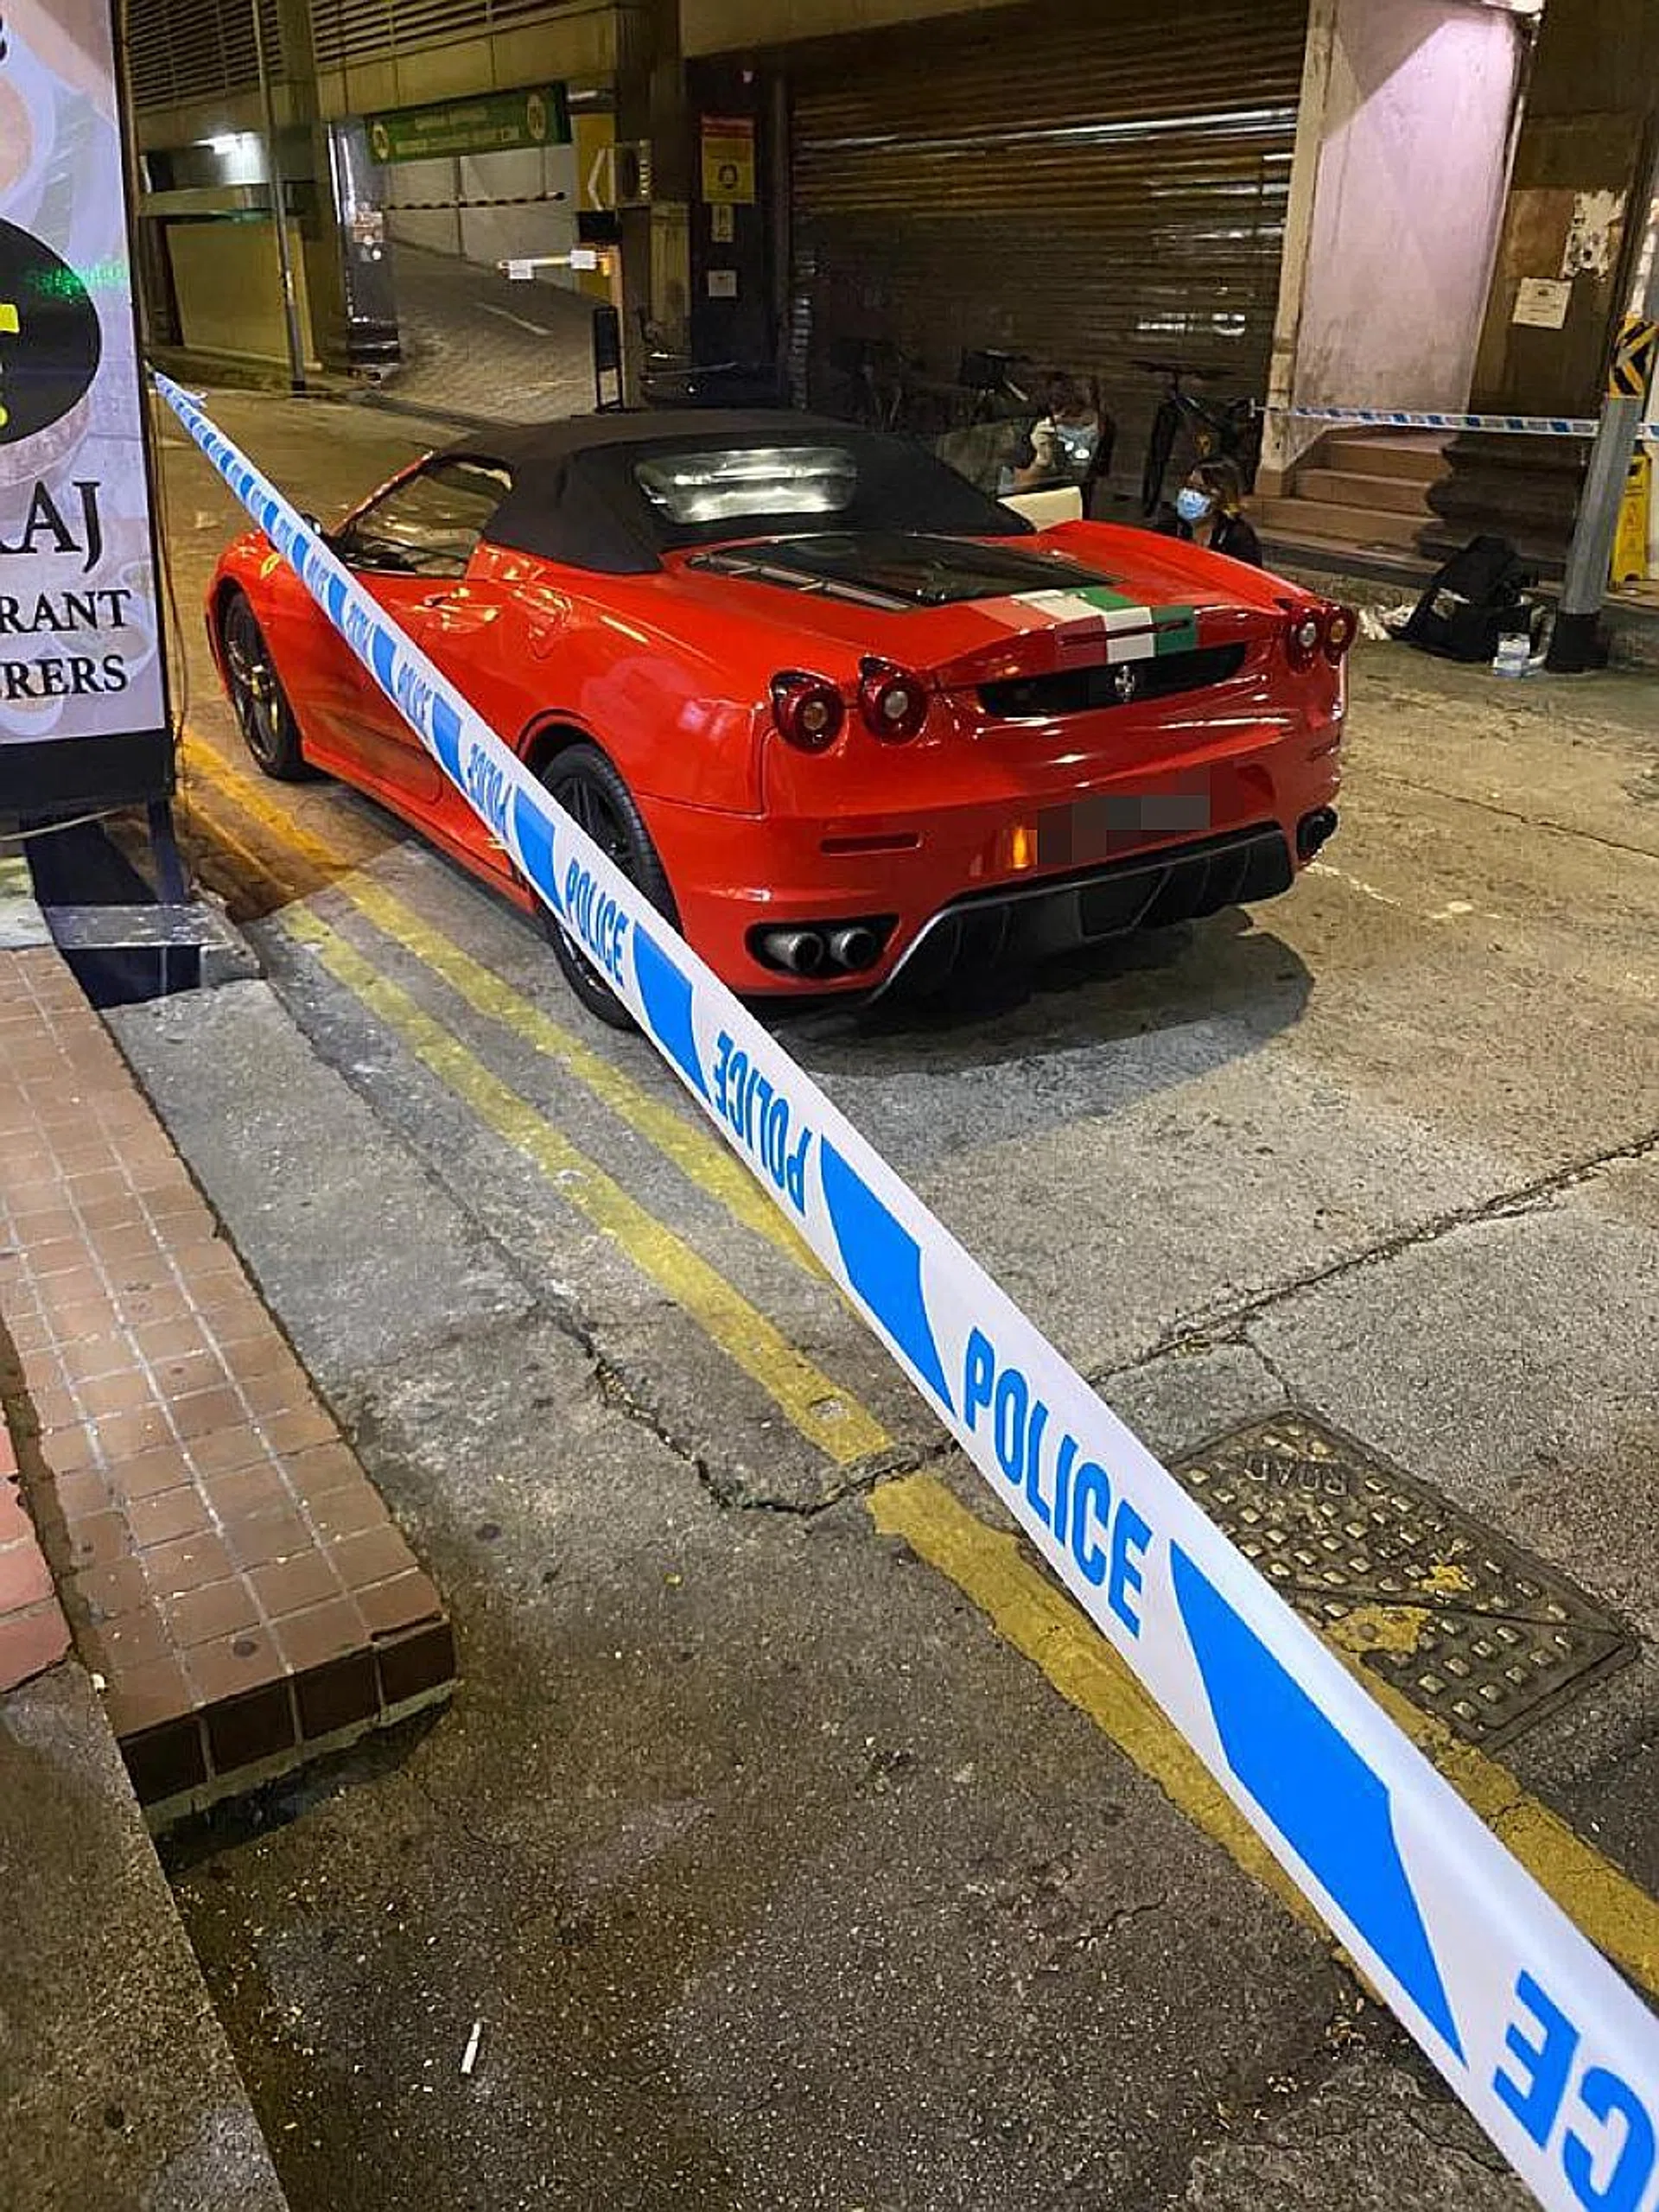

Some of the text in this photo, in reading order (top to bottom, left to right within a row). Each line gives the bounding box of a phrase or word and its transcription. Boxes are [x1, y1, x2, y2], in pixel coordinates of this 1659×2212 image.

[0, 480, 102, 573] AJ
[565, 857, 629, 985] POLICE
[714, 1030, 813, 1217] POLICE
[963, 1327, 1154, 1638] POLICE
[1492, 1968, 1659, 2212] CE
